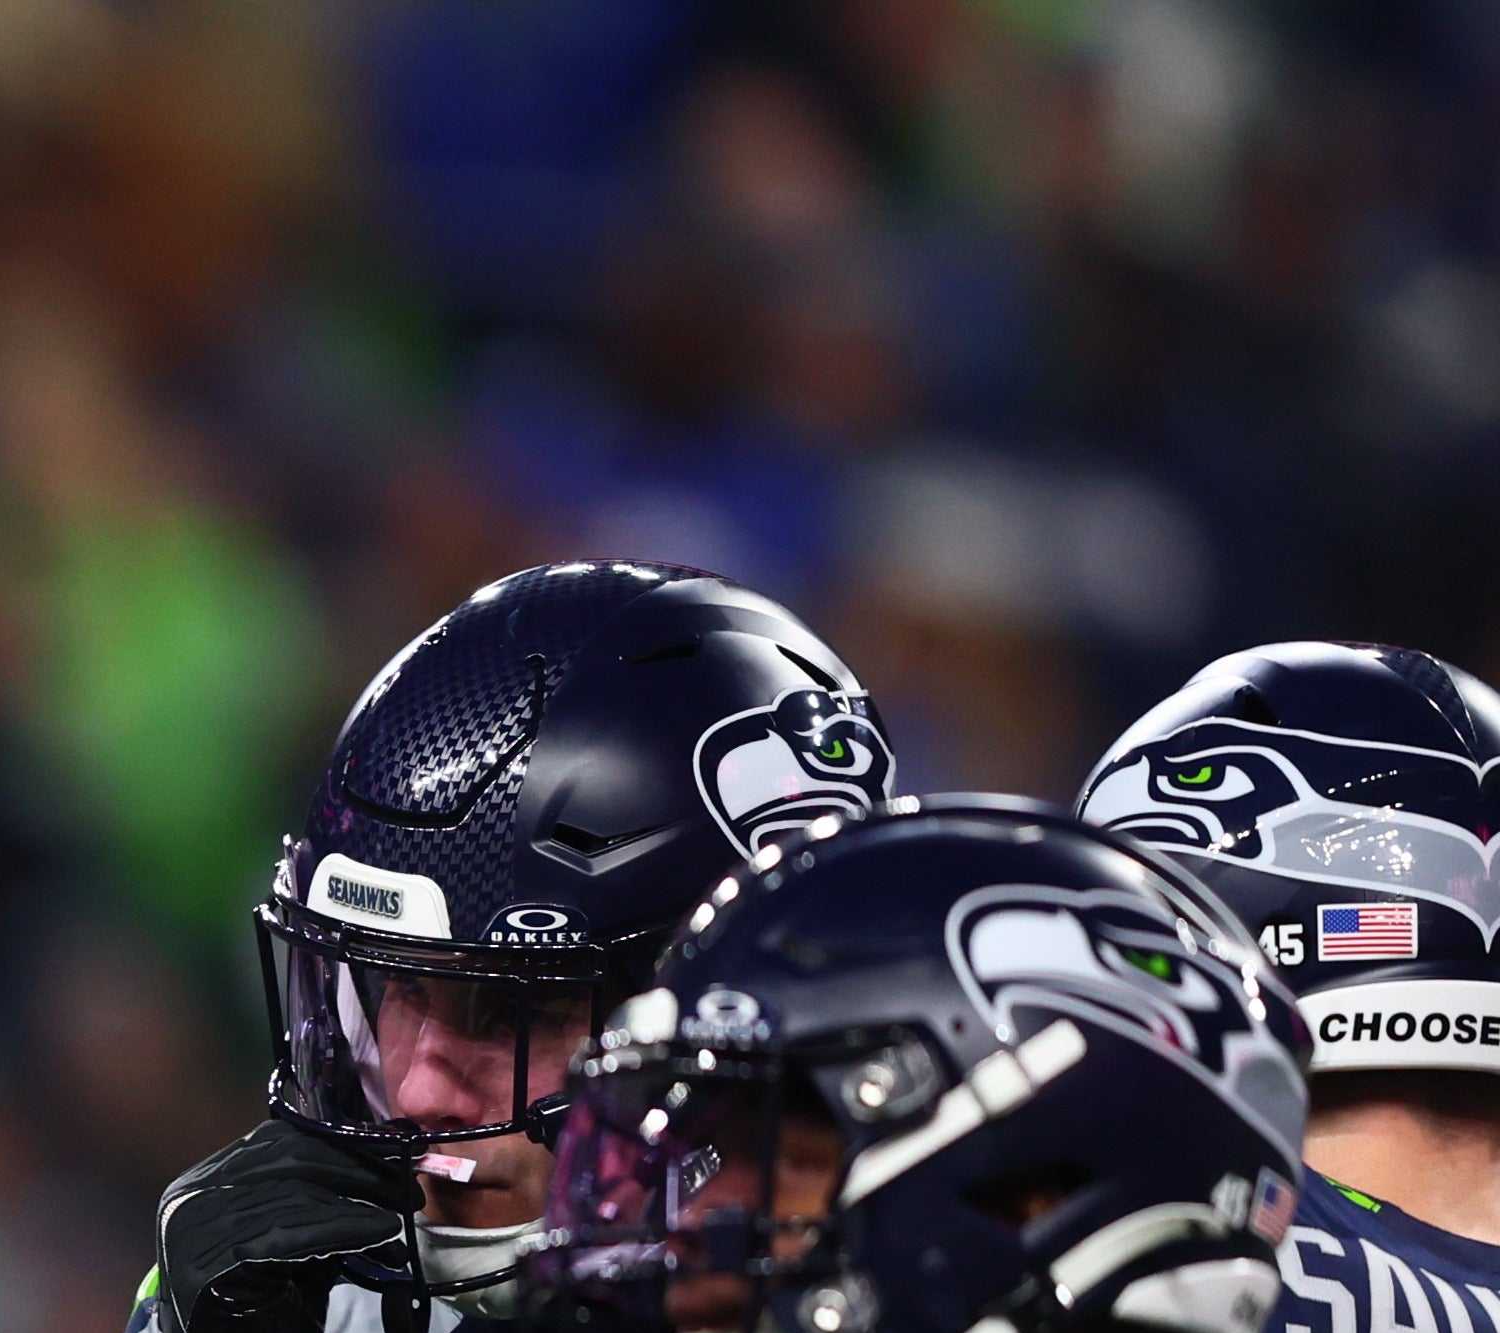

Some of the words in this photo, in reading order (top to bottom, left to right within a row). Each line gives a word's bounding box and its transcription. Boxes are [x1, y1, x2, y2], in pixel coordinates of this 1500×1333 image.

[327, 874, 401, 916] SEAHAWKS
[490, 931, 582, 943] OAKLEY
[1257, 923, 1305, 966] 45
[1318, 1011, 1500, 1047] CHOOSE
